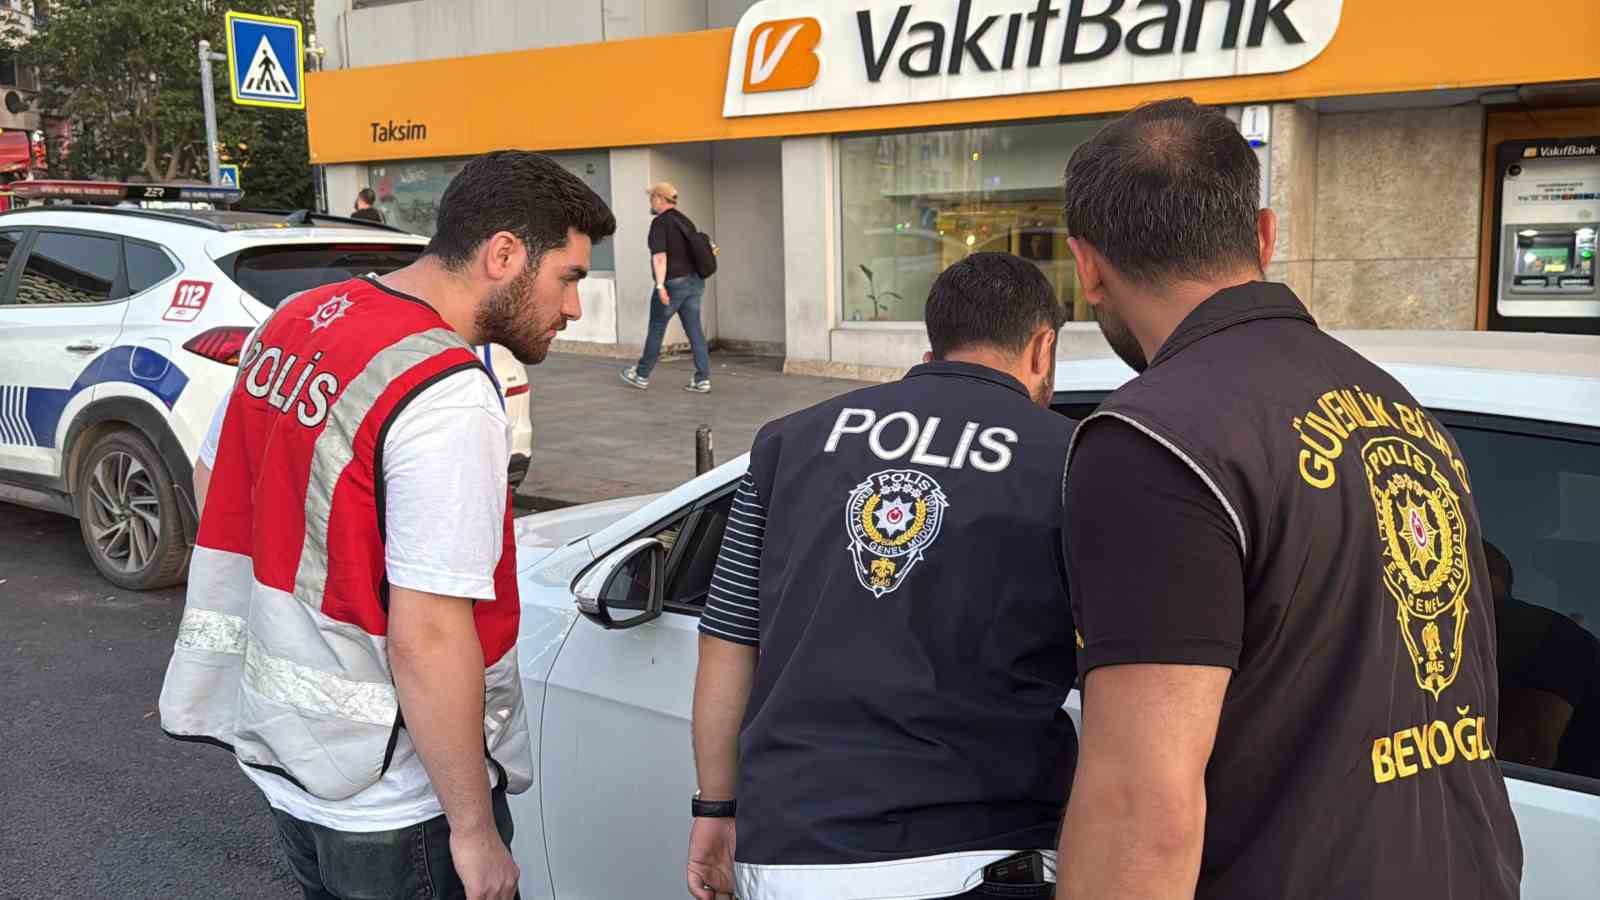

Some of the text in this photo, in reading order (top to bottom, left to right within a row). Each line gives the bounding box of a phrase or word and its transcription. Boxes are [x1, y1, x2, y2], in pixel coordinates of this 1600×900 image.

[370, 119, 427, 143] Taksim
[177, 284, 206, 307] 112
[1371, 705, 1490, 784] BEYOĞL
